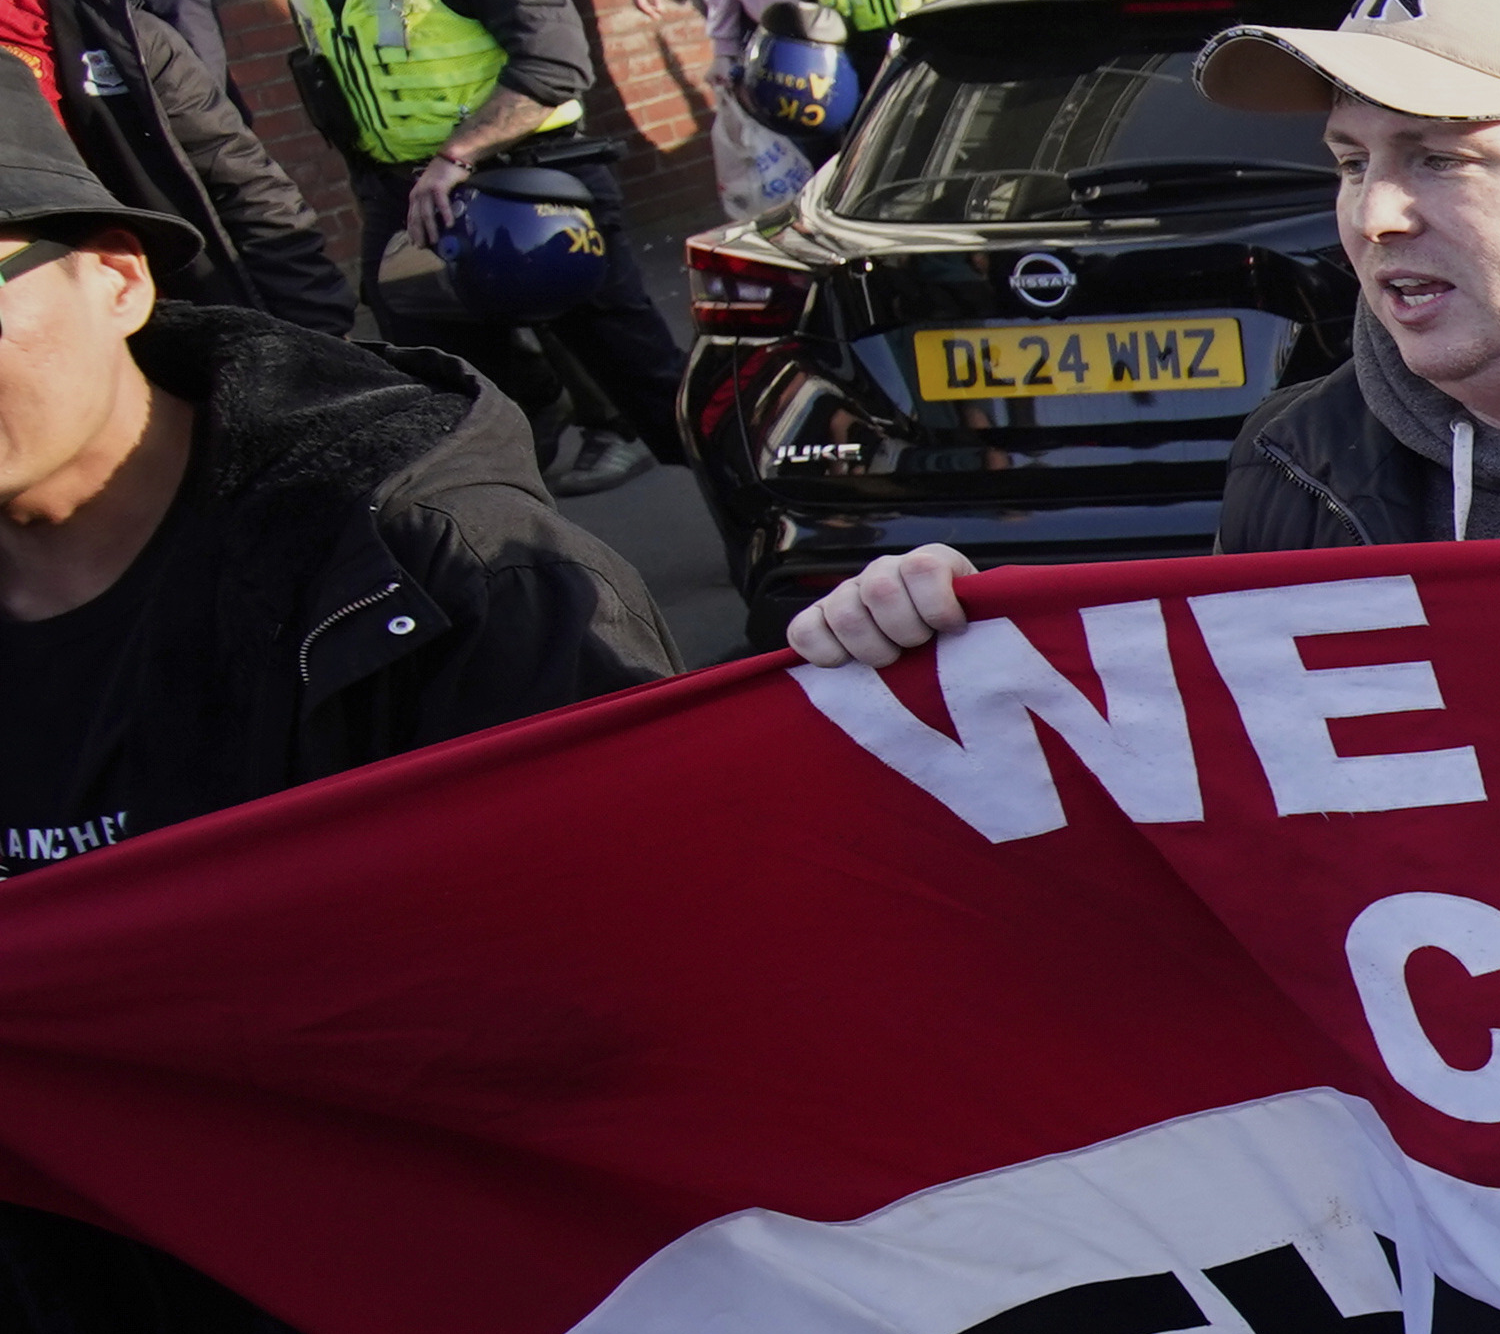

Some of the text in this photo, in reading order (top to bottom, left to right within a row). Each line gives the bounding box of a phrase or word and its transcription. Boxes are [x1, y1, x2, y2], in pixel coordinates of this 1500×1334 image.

[1010, 273, 1077, 290] NISSAN
[943, 327, 1220, 390] DL24 WMZ
[775, 443, 862, 465] JUKE
[786, 575, 1487, 844] WE
[0, 811, 128, 860] ANCHE
